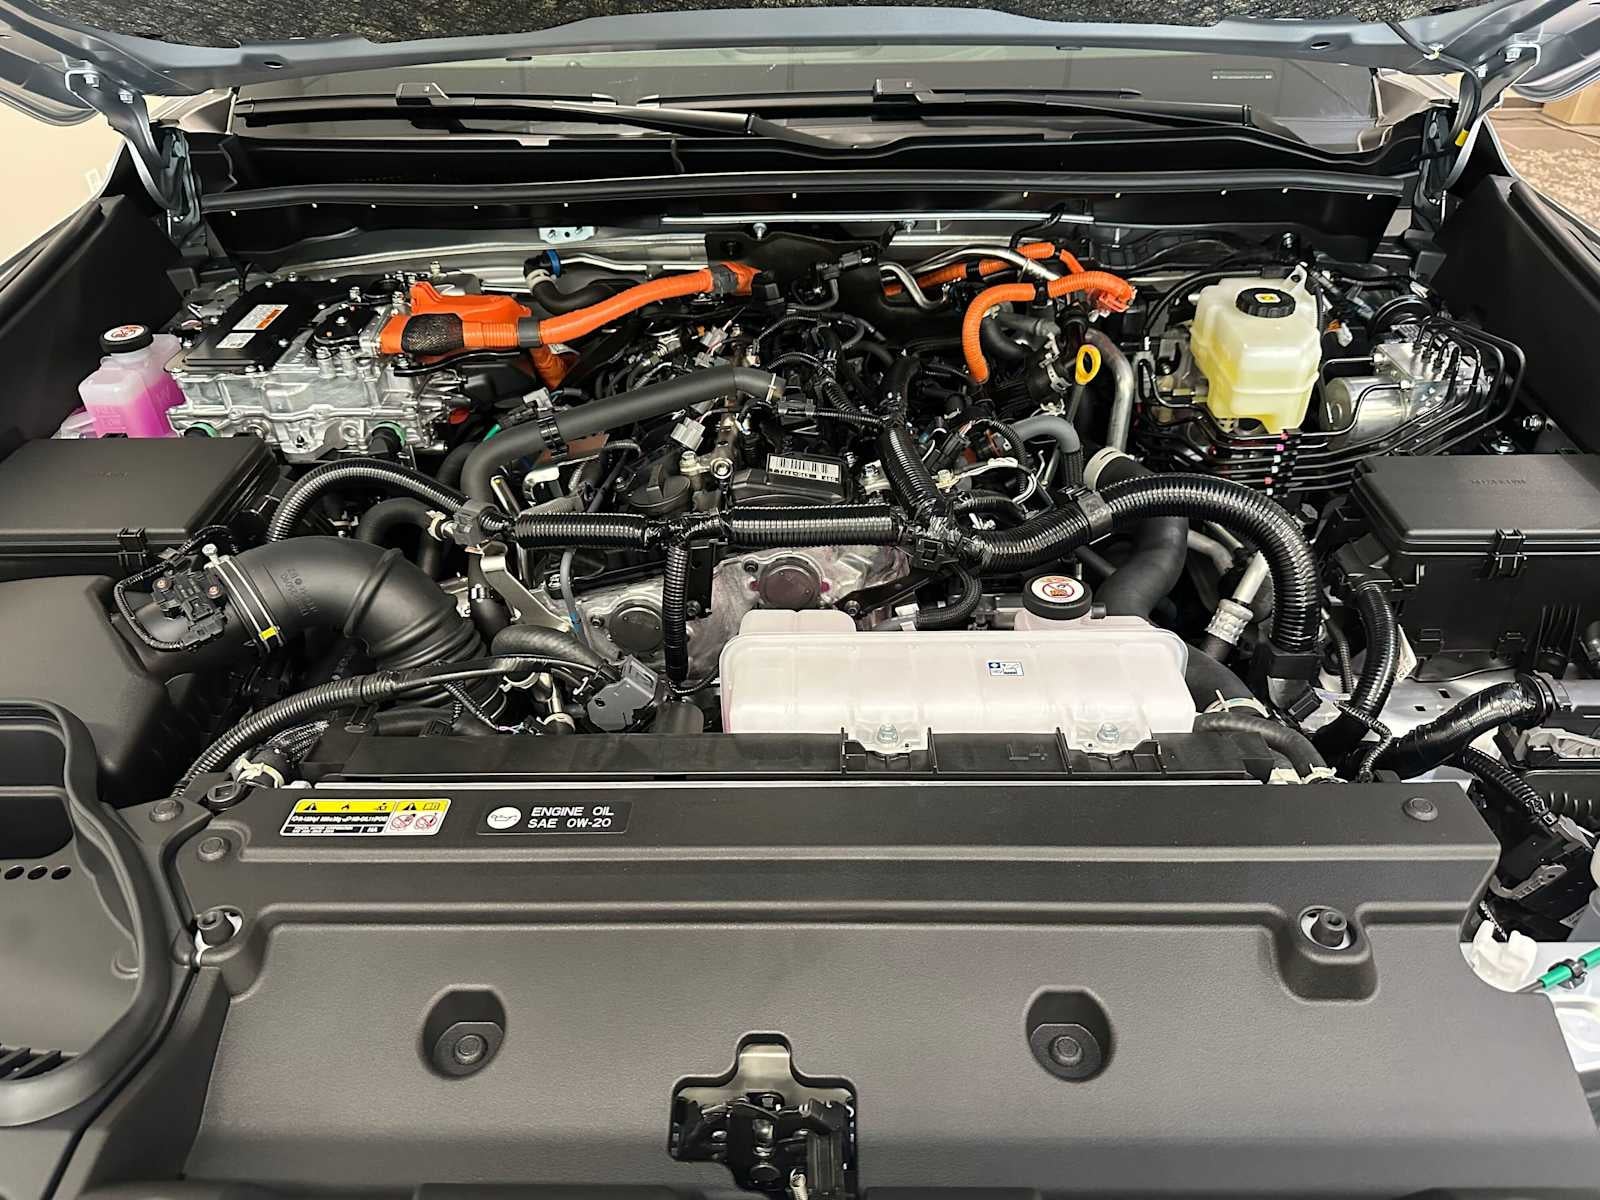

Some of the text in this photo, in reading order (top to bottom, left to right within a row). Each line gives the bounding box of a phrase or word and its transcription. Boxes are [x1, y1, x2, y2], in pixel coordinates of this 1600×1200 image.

[531, 806, 615, 817] ENGINE OIL
[527, 817, 612, 828] SAE 0W-20
